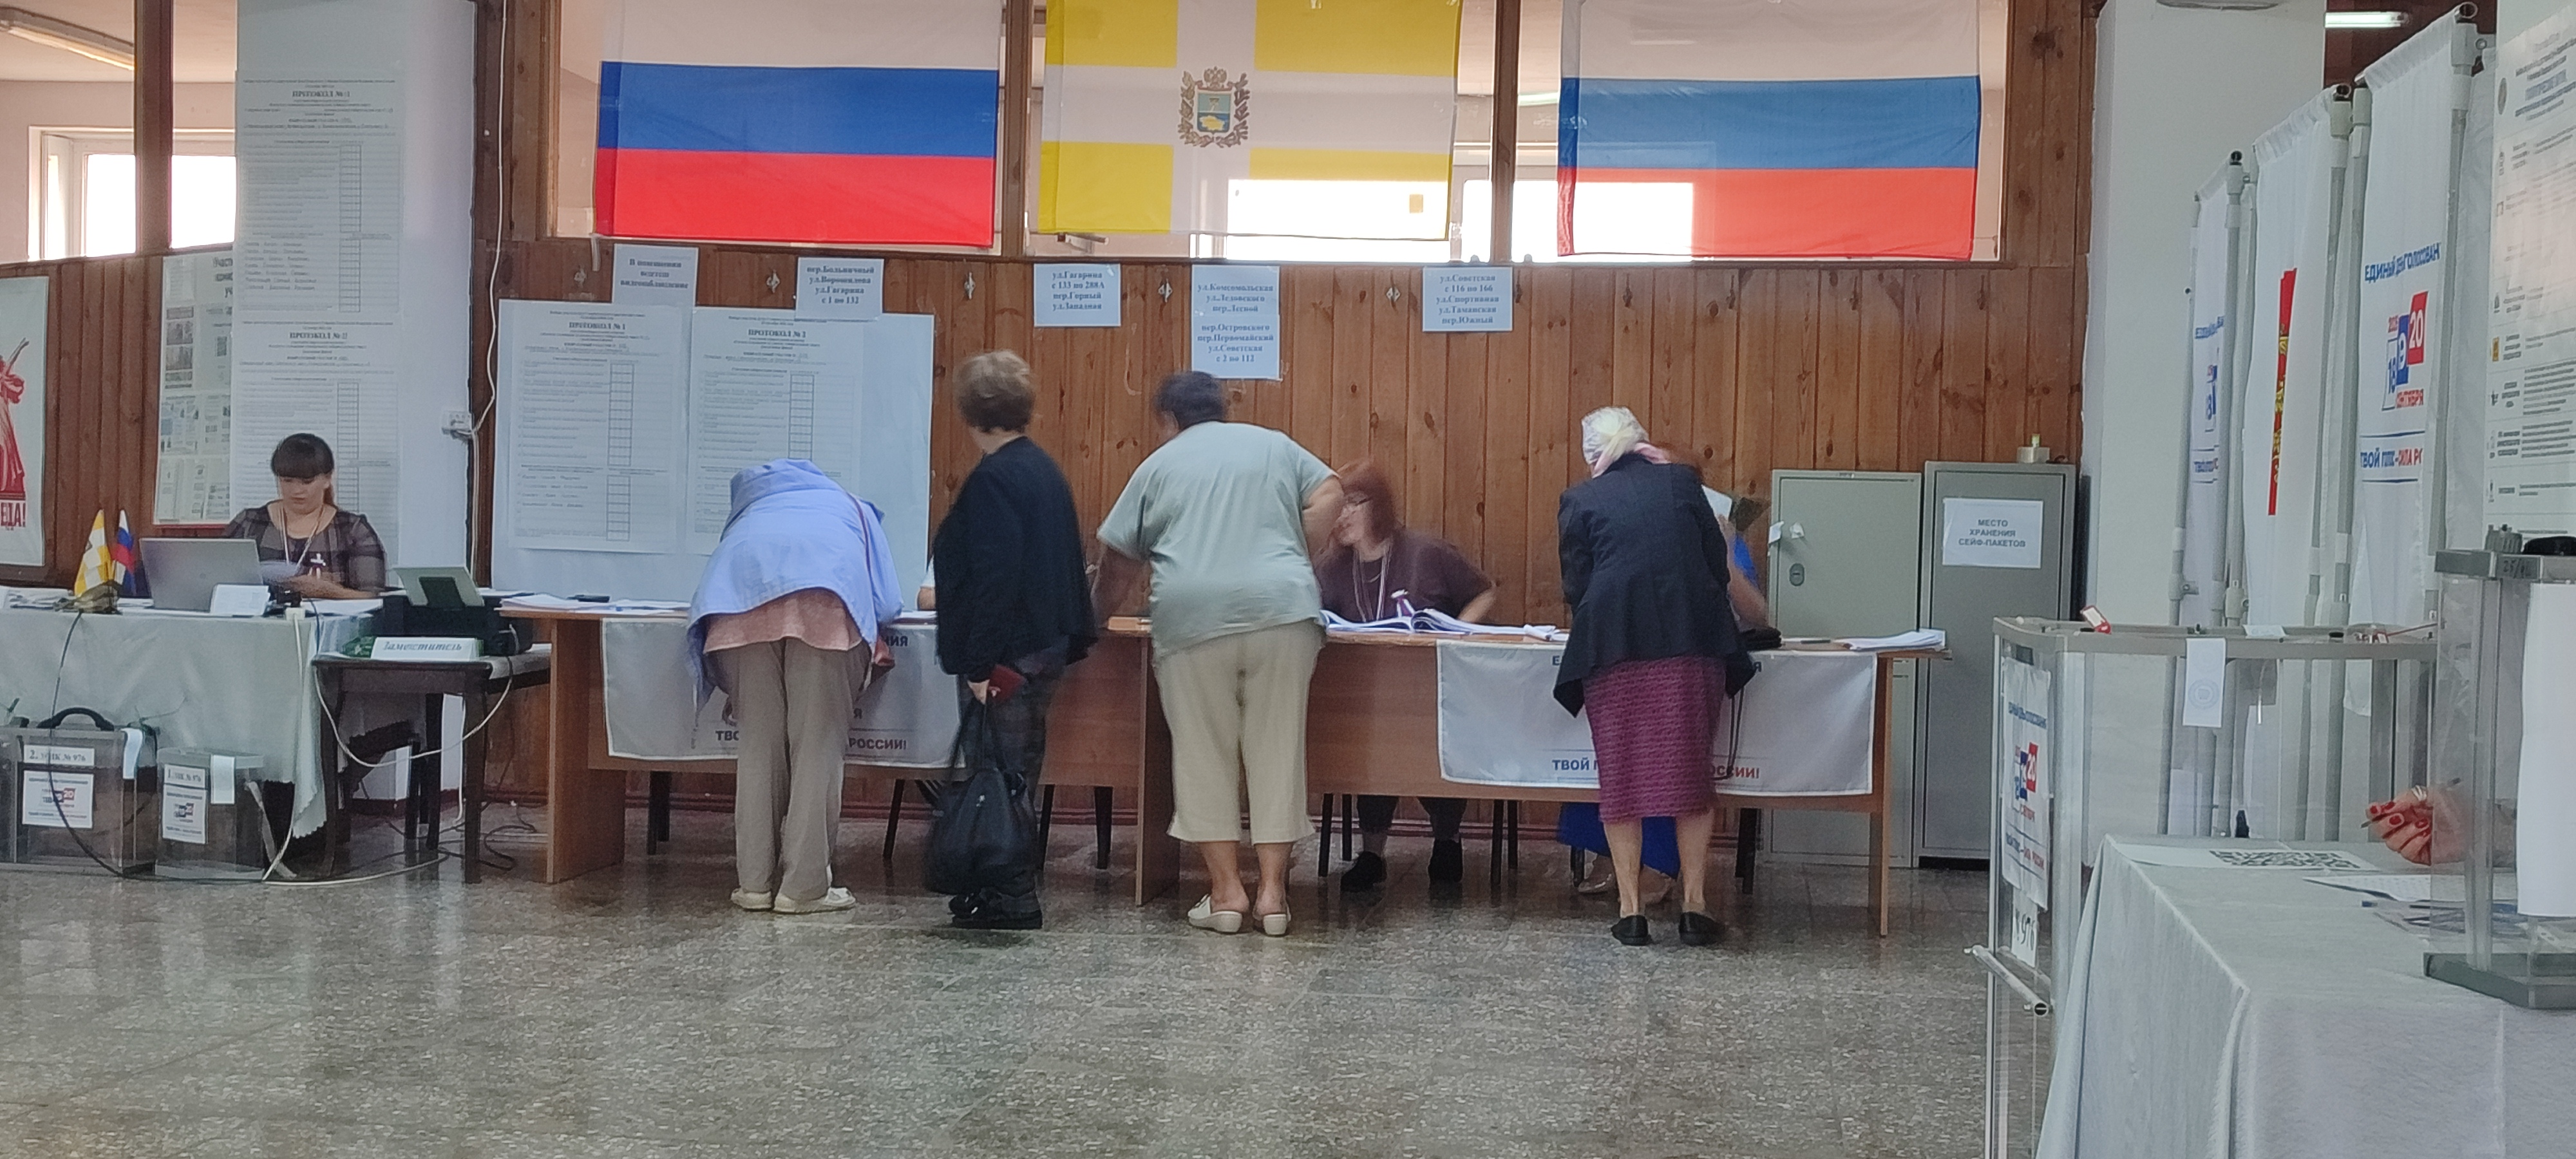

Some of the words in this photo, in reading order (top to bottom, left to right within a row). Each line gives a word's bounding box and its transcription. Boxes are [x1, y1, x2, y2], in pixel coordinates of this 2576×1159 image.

[1052, 270, 1103, 281] ул.Гагарина
[1439, 274, 1495, 284] ул.Советская
[1059, 281, 1071, 289] 133
[1197, 283, 1273, 292] ул.Комсомольская
[1452, 285, 1465, 293] 116
[815, 286, 864, 296] ул.Гагарина
[1053, 292, 1102, 301] пер.Горный
[1436, 296, 1499, 305] ул.Спортивная
[1438, 306, 1497, 316] ул.Таманская
[1441, 316, 1493, 326] пер.Южный
[1202, 323, 1270, 333] пер.Островского
[2409, 309, 2423, 350] 20
[748, 329, 791, 337] ПРОТОКОЛ
[1197, 334, 1274, 343] пер.Первомайский
[1208, 344, 1263, 353] ул.Советская
[1978, 519, 2008, 527] МЕСТО
[1969, 529, 2016, 537] ХРАНЕНИЯ
[1958, 537, 2026, 547] СЕЙФ-ПАКЕТОВ
[383, 641, 462, 651] Заместитель
[1552, 757, 1589, 771] ТВОЙ
